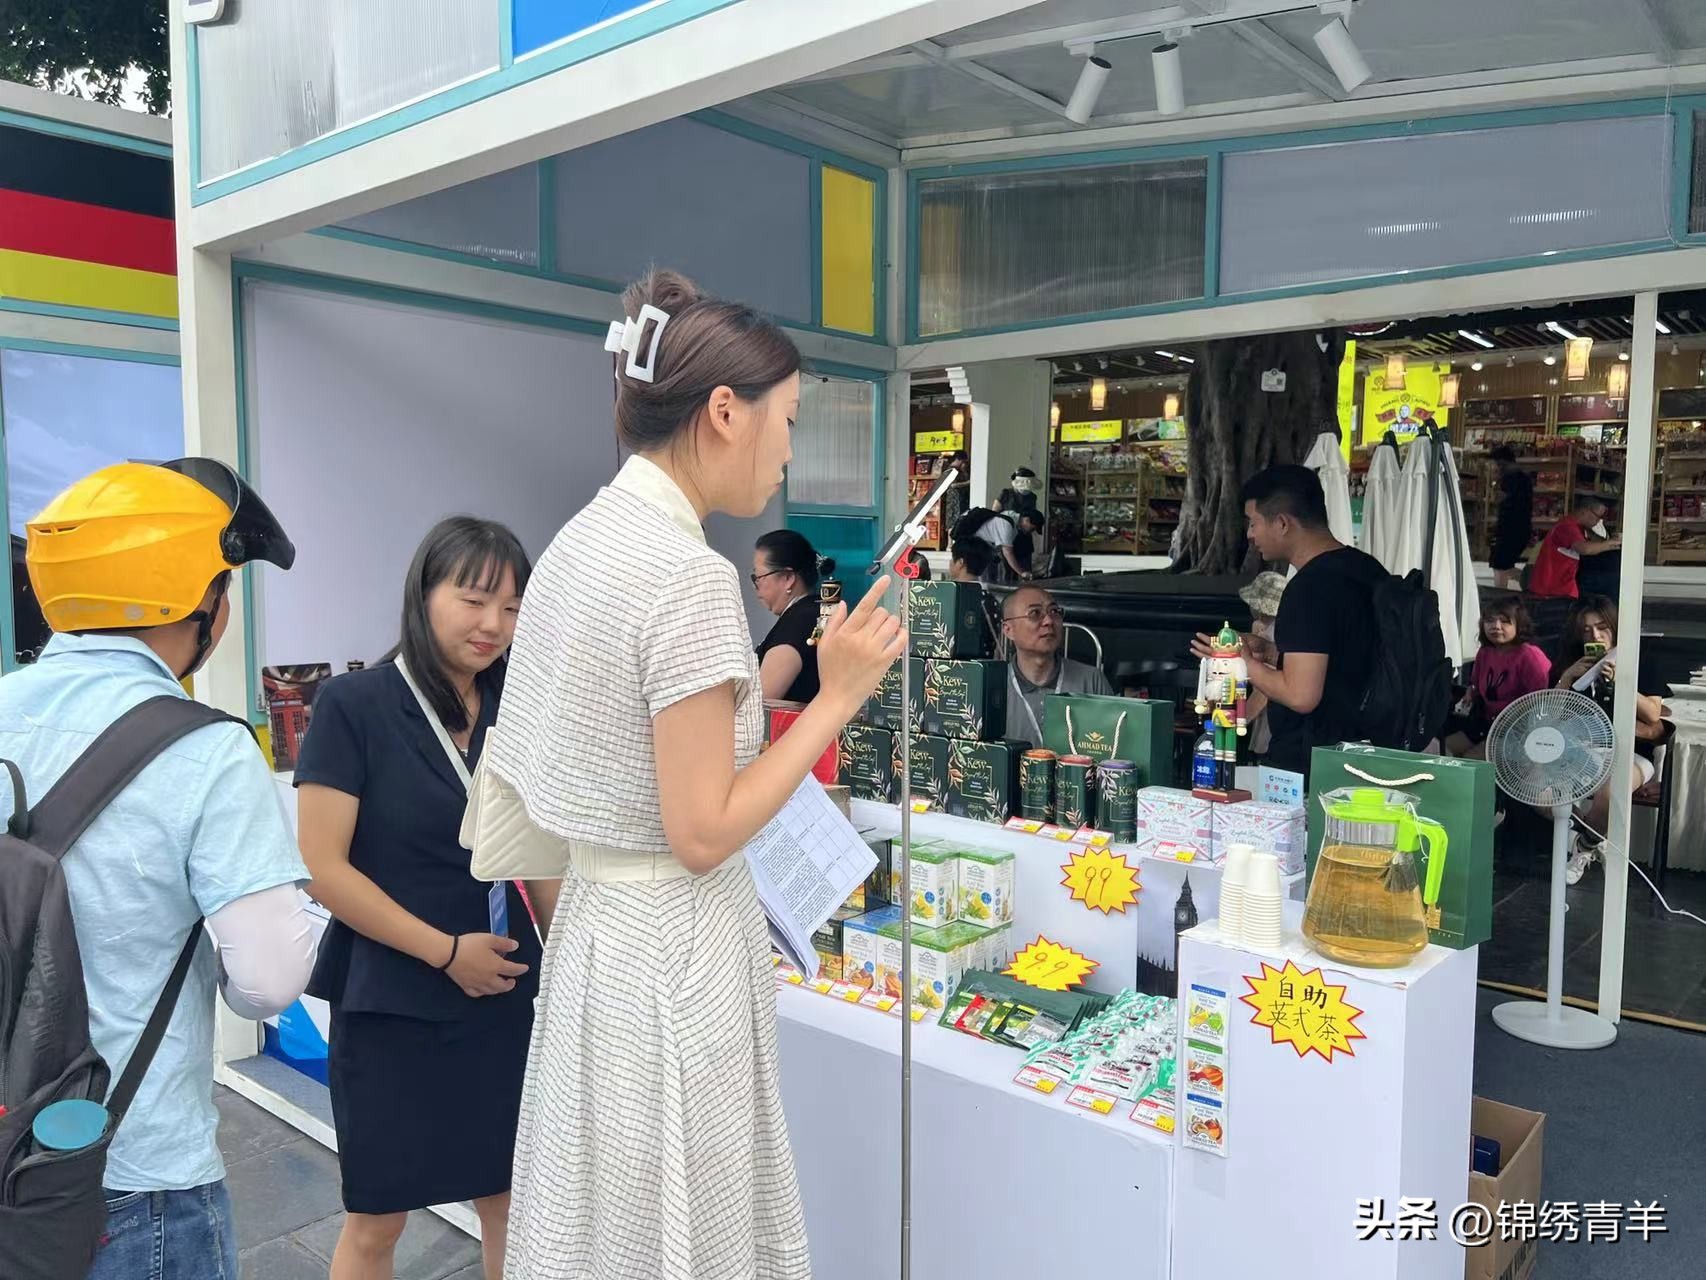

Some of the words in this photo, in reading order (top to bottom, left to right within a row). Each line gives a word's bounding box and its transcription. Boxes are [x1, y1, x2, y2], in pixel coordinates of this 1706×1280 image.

[918, 596, 937, 607] Kew
[943, 675, 962, 687] Kew
[855, 741, 873, 752] Kew
[1077, 741, 1100, 751] AHMAD
[1101, 743, 1112, 752] TEA
[910, 749, 929, 760] Kew
[967, 757, 987, 769] Kew
[1028, 775, 1048, 785] Kew
[1085, 866, 1112, 902] 99
[1025, 952, 1069, 978] 9.9
[1279, 976, 1328, 1009] 自助
[1267, 1000, 1340, 1043] 英式茶
